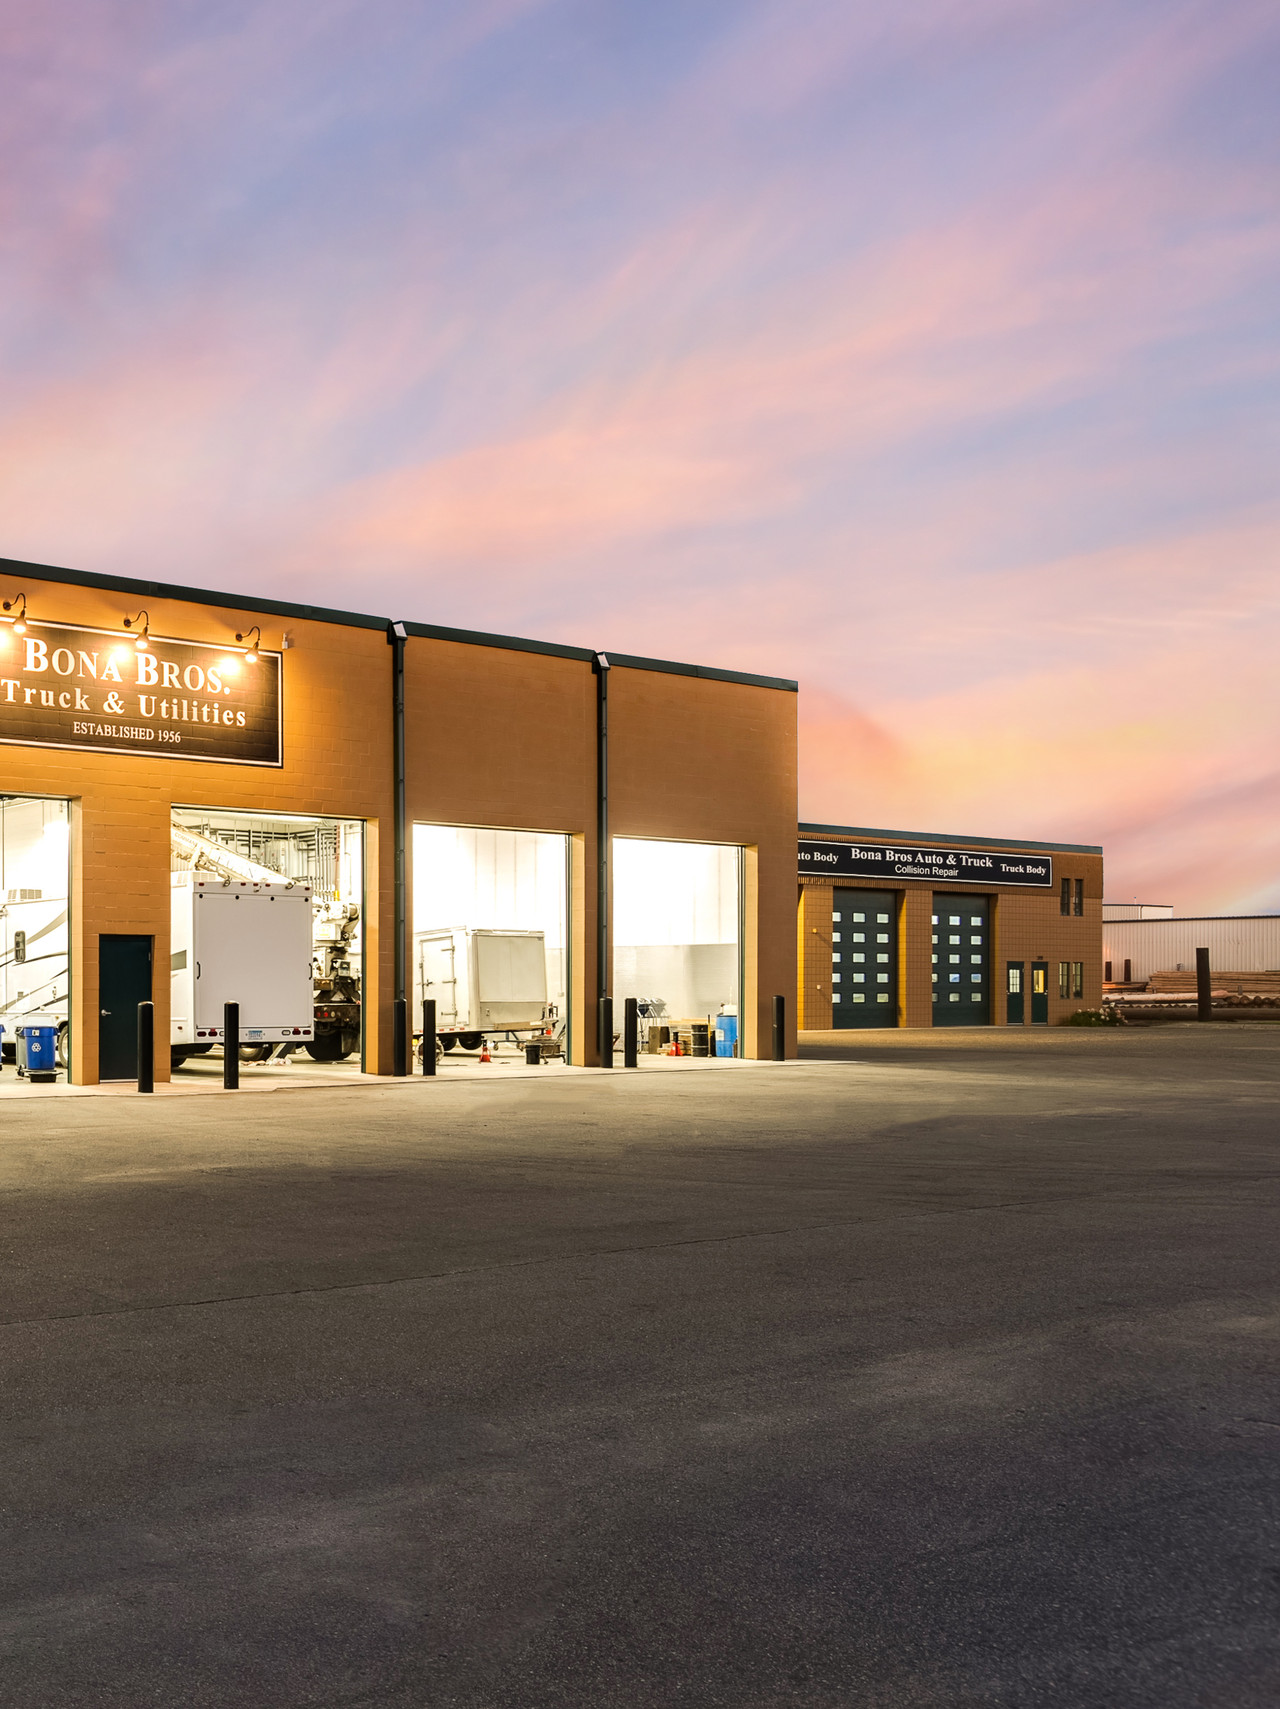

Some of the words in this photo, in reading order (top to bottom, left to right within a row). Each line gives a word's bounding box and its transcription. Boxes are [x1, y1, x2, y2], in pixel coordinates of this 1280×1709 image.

[22, 637, 124, 683] BONA
[134, 651, 231, 695] BROS.
[0, 678, 91, 711] Truck
[102, 691, 125, 714] &
[137, 694, 246, 727] Utilities
[73, 721, 155, 741] ESTABLISHED
[157, 730, 181, 744] 1956
[813, 851, 839, 865] Body
[851, 847, 882, 860] Bona
[885, 850, 913, 862] Bros
[914, 852, 944, 864] Auto
[946, 853, 957, 865] &
[959, 854, 993, 867] Truck
[894, 864, 931, 875] Collision
[932, 866, 959, 877] Repair
[1000, 863, 1025, 873] Truck
[1026, 865, 1047, 876] Body
